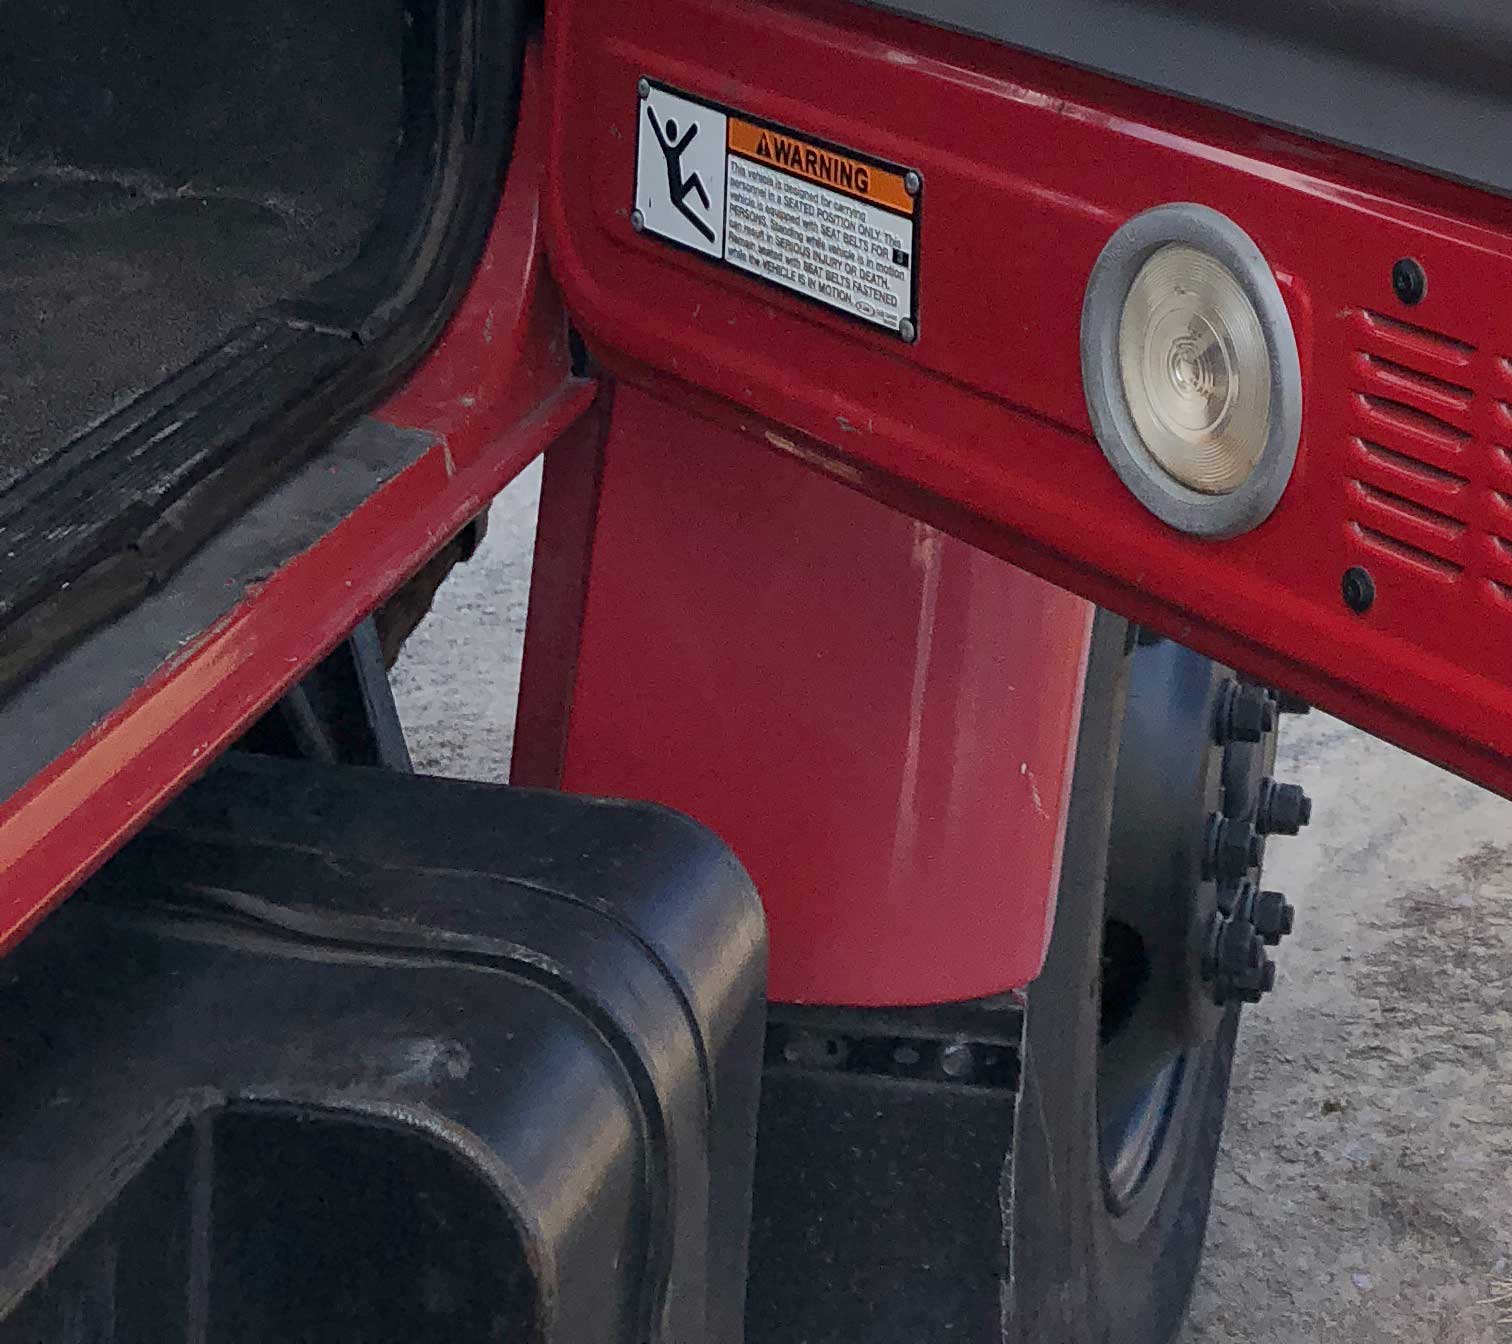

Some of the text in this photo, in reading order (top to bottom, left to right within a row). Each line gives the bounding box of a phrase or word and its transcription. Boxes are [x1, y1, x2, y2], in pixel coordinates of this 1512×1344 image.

[730, 161, 866, 223] This vehicle is designed for carrying
[774, 137, 869, 194] WARNING
[729, 203, 905, 281] PERSONS. Standing while vehicle is in motion
[730, 177, 766, 198] personnel
[768, 191, 775, 203] in
[783, 195, 815, 217] SEATED
[816, 207, 856, 233] POSITION
[858, 223, 882, 242] ONLY.
[884, 232, 901, 249] This
[730, 191, 756, 209] vehicle
[757, 201, 764, 212] is
[765, 205, 801, 227] equipped
[802, 219, 819, 234] with
[820, 223, 841, 240] SEAT
[843, 231, 869, 252] BELTS
[871, 243, 889, 260] FOR
[727, 247, 854, 306] while the VEHICLE IS IN MOTION.
[728, 230, 898, 308] Remain seated with SEAT BELTS FASTENED
[729, 219, 890, 290] can result in SERIOUS INJURY OR DEATH.
